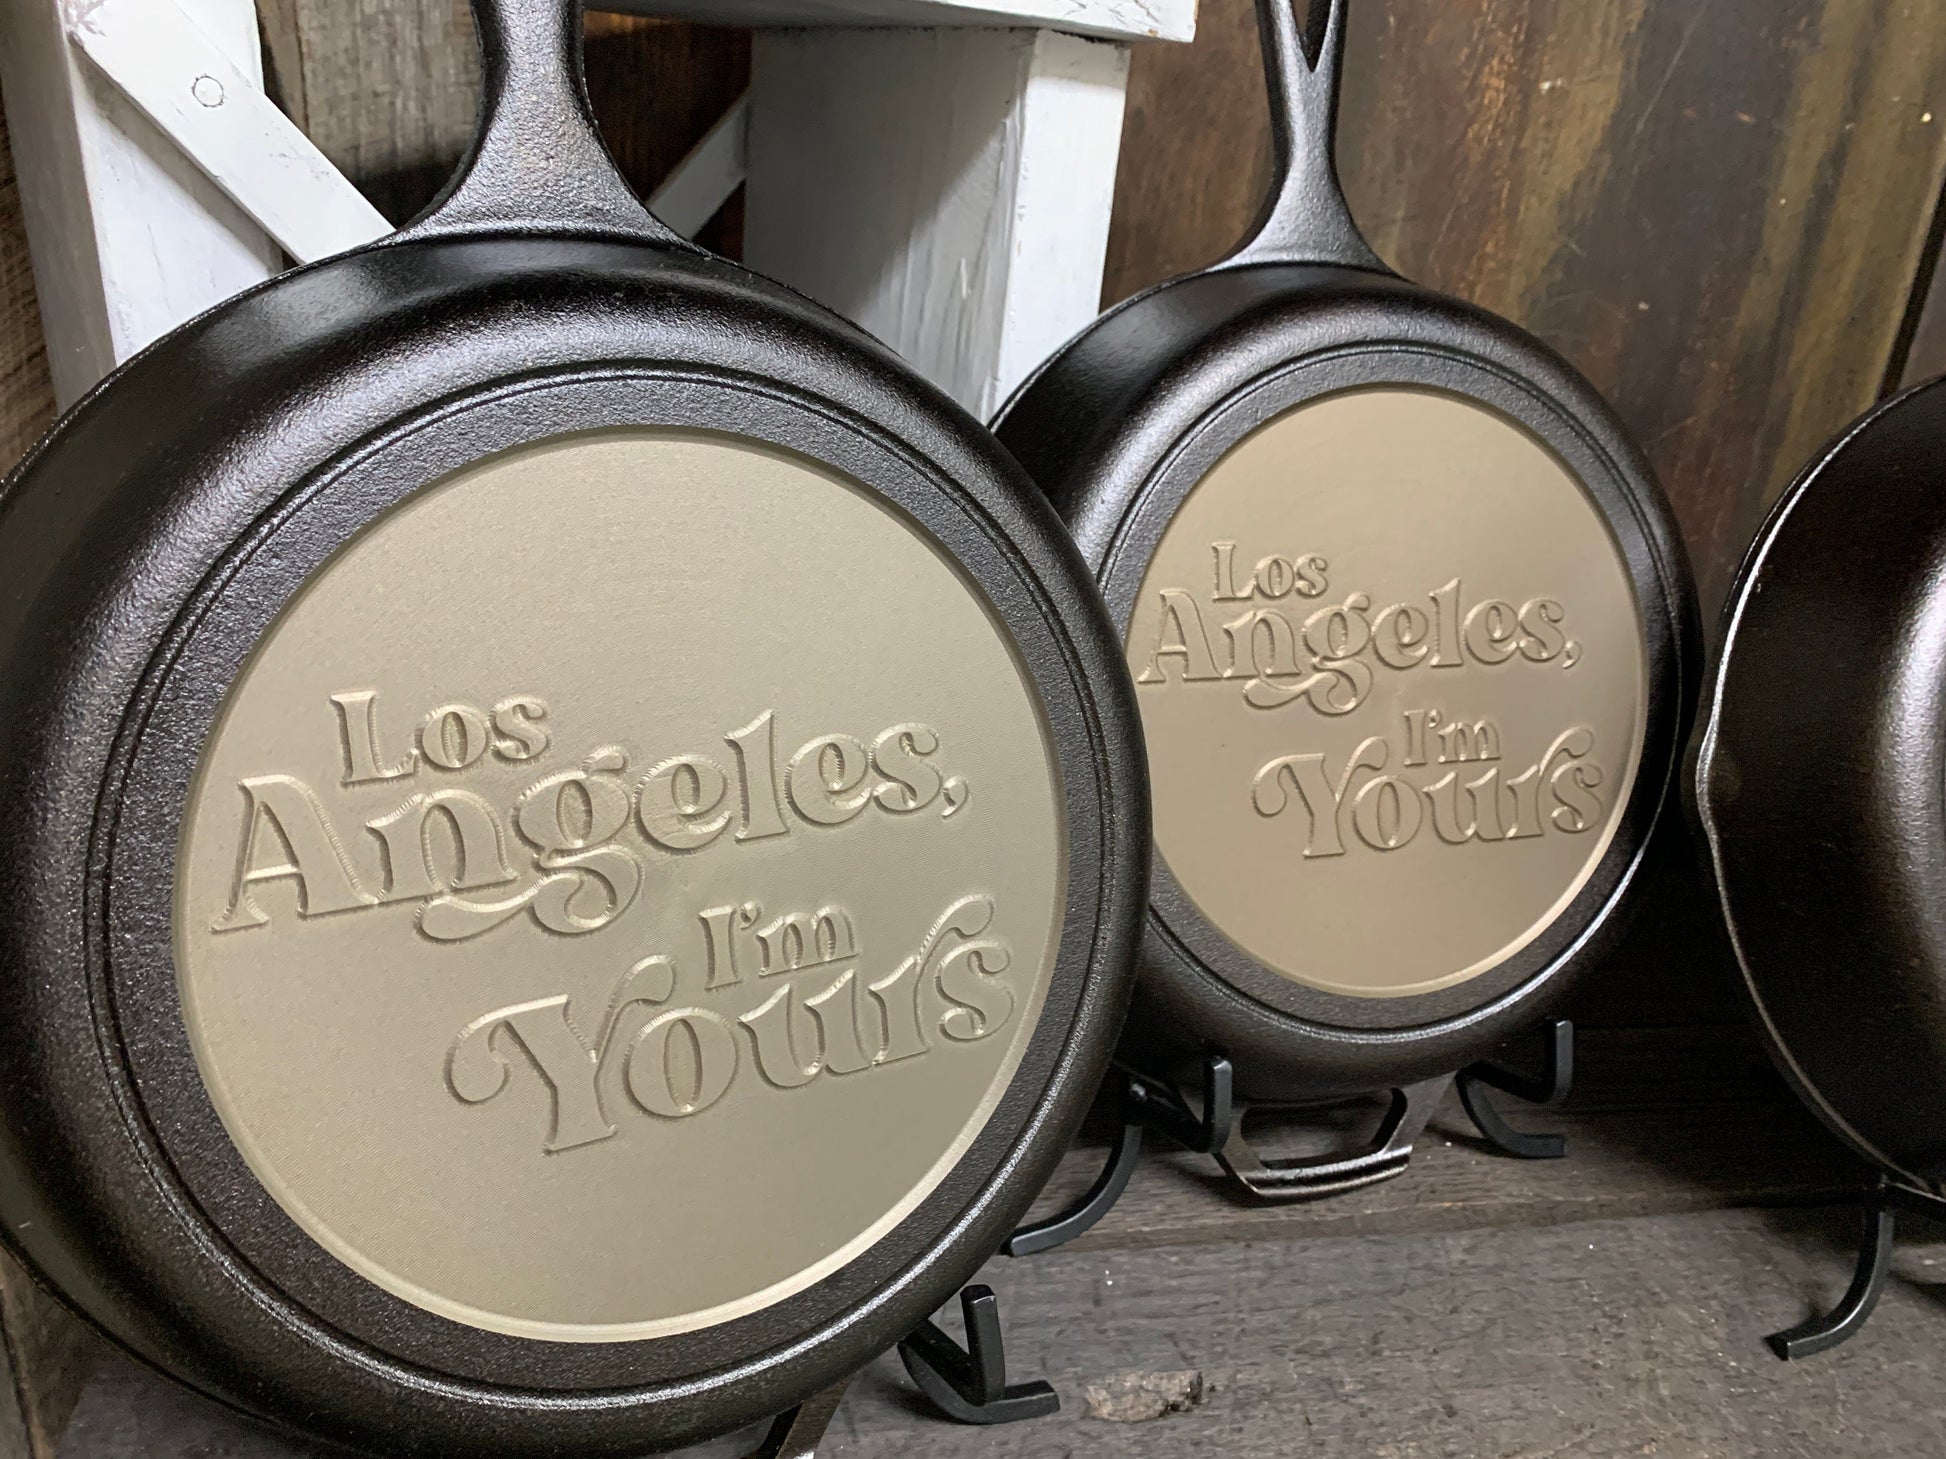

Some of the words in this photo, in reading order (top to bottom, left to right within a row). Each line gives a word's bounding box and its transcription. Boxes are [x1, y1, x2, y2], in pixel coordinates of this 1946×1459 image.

[1210, 539, 1329, 601] Los
[1136, 577, 1583, 715] Angeles,
[330, 689, 552, 788] Los
[1251, 725, 1603, 858] Yours
[1403, 708, 1502, 766] I'm
[207, 709, 970, 942] Angeles,
[698, 901, 860, 991] I'm
[443, 893, 1015, 1156] Yours
